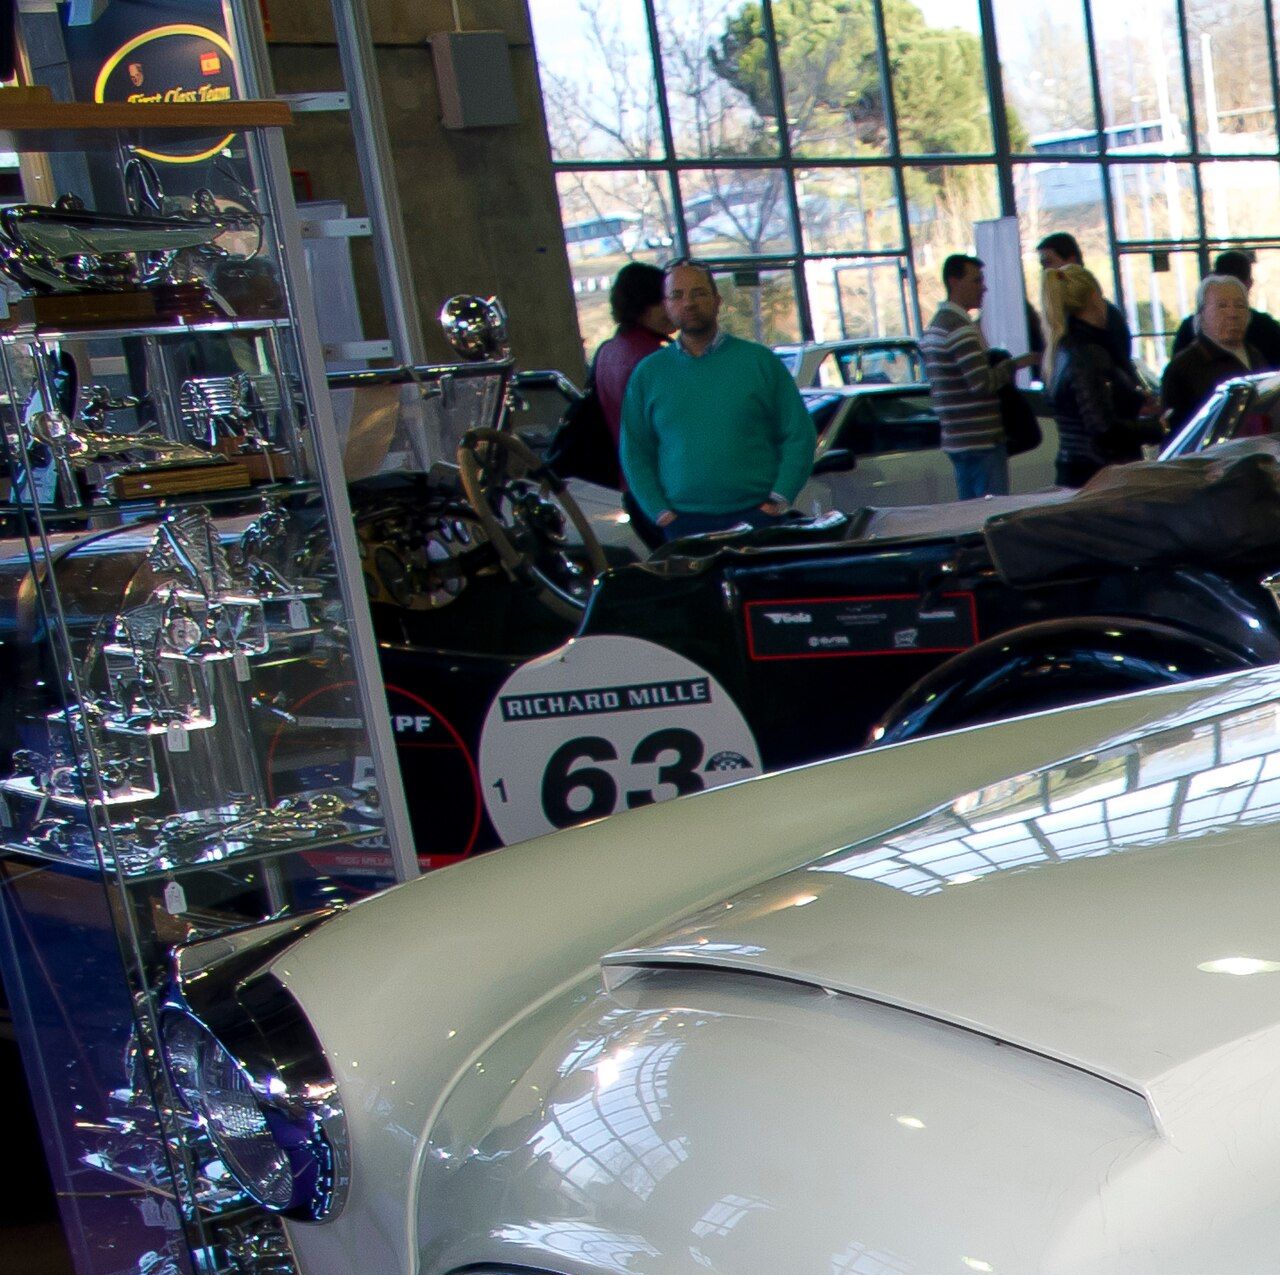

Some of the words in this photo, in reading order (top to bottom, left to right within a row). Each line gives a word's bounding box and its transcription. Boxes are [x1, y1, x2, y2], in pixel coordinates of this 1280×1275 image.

[164, 86, 197, 103] Class
[199, 83, 231, 102] Team
[506, 691, 620, 717] RICHARD
[628, 682, 706, 706] MILLE
[391, 715, 432, 733] PF
[541, 727, 705, 830] 63
